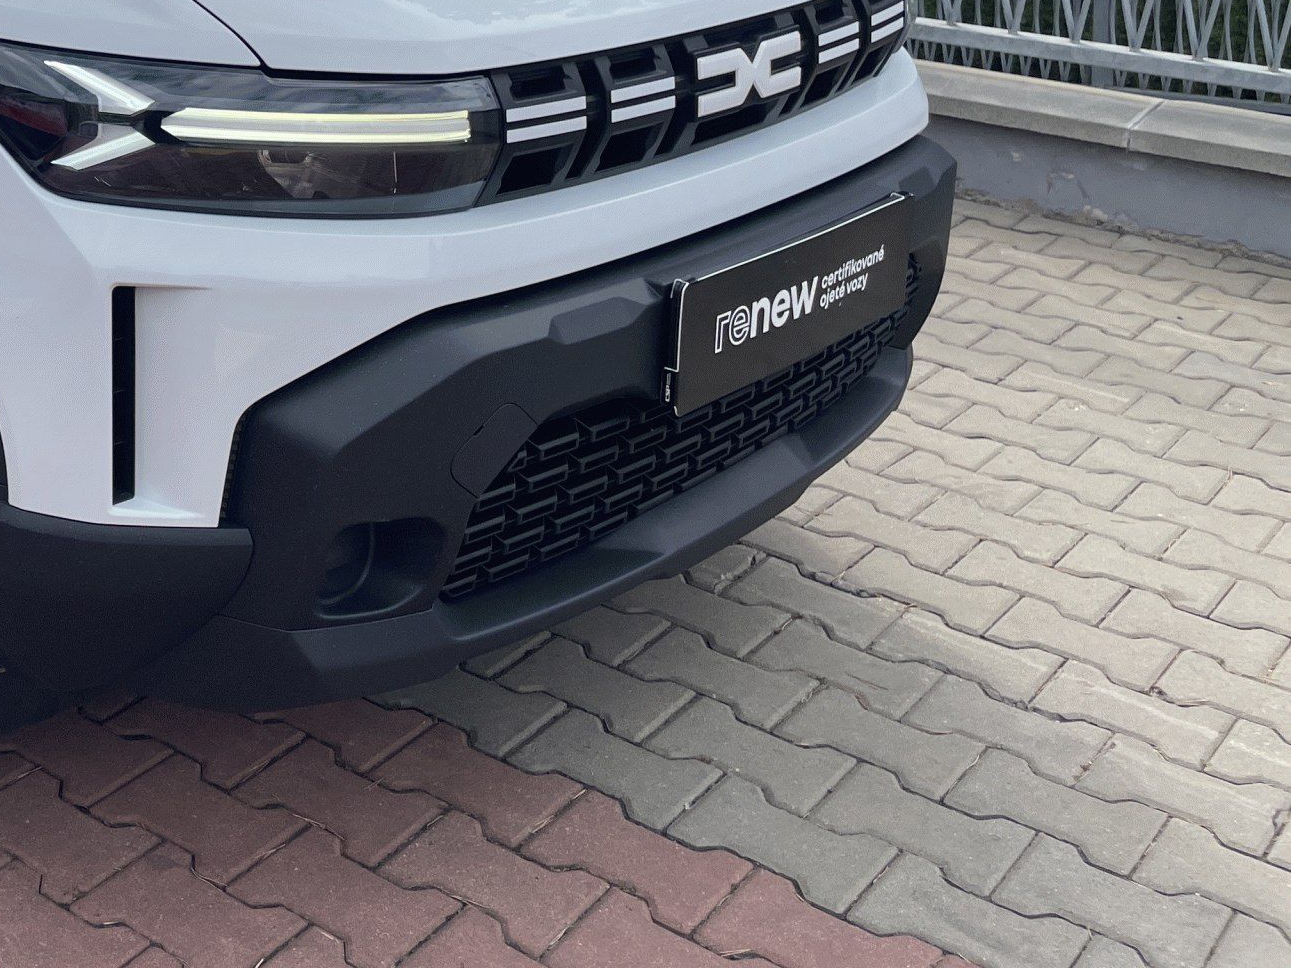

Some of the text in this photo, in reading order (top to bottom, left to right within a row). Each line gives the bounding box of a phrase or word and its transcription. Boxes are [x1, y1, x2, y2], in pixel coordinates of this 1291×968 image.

[821, 243, 885, 289] certifikované
[819, 272, 868, 310] ojeté vozy
[714, 276, 818, 354] renew
